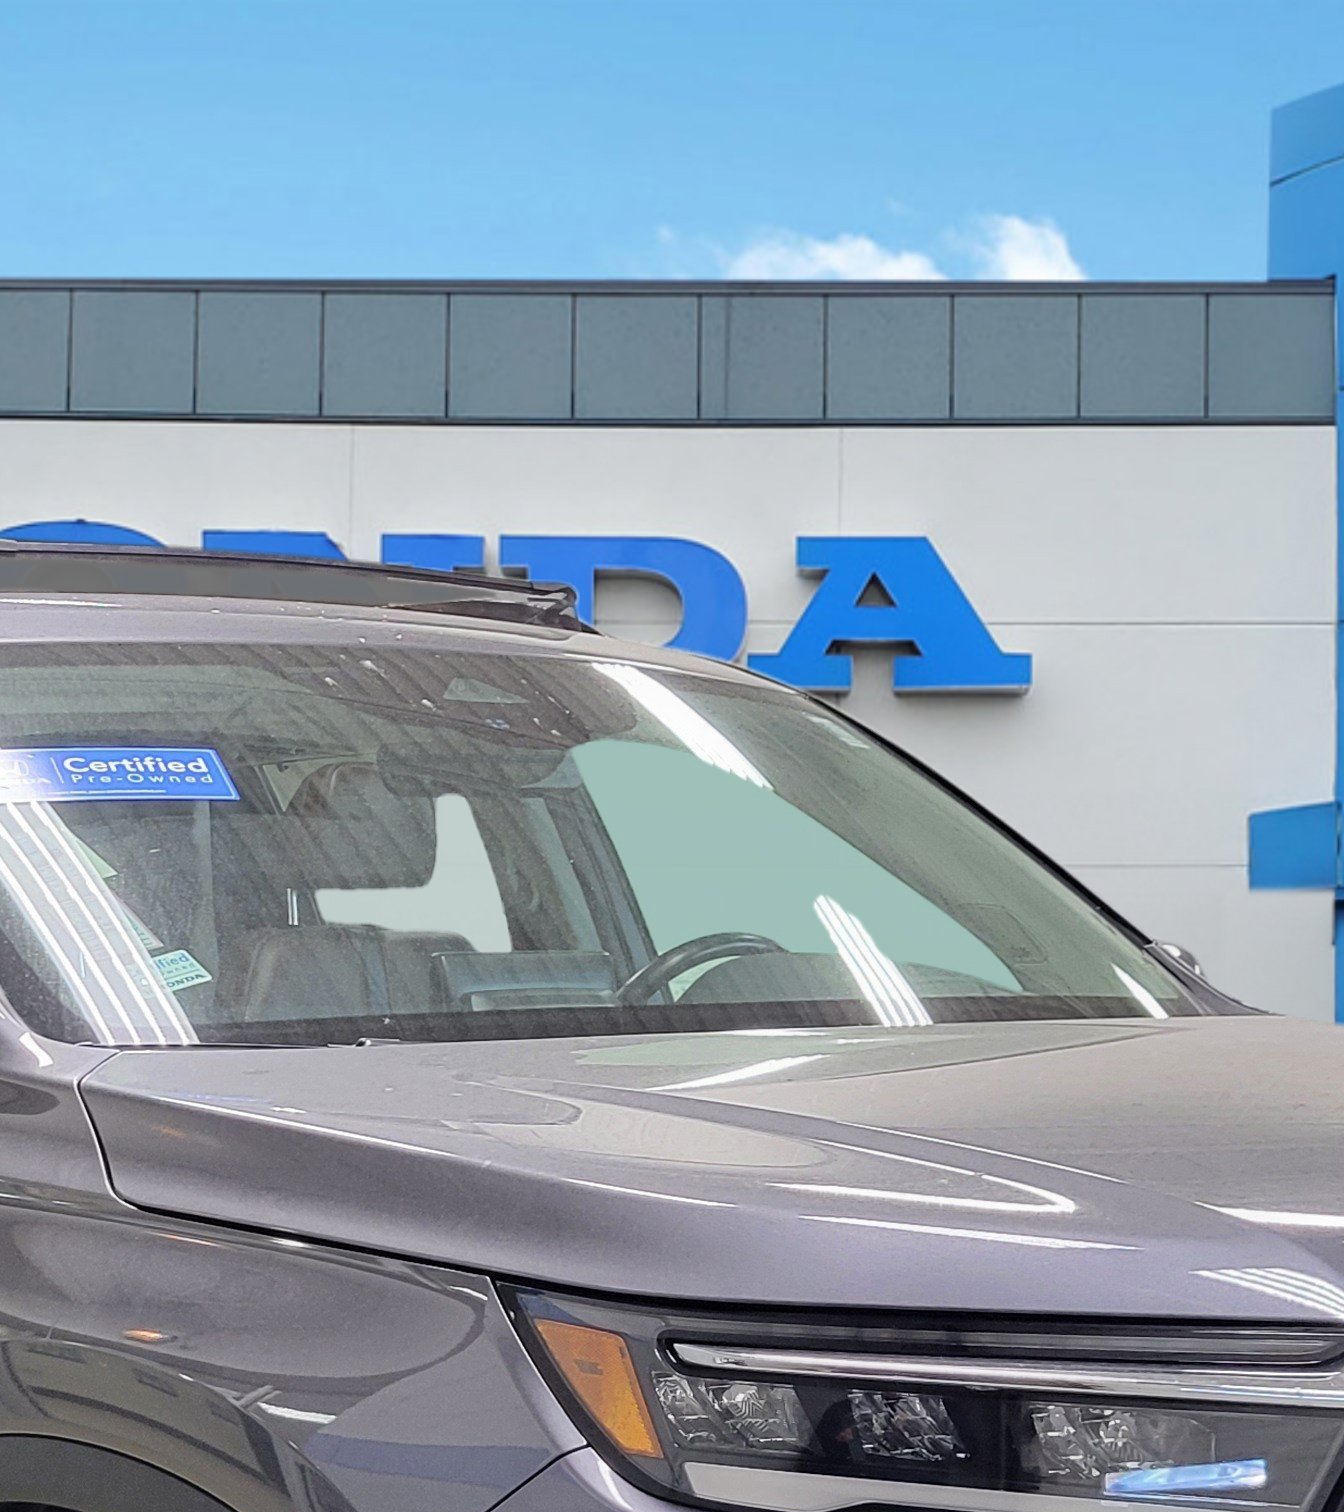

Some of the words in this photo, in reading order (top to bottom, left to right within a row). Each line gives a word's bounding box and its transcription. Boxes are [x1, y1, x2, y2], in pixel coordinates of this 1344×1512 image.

[63, 756, 208, 773] Certified
[71, 773, 213, 783] Pre-Owned
[166, 974, 206, 988] ONDA
